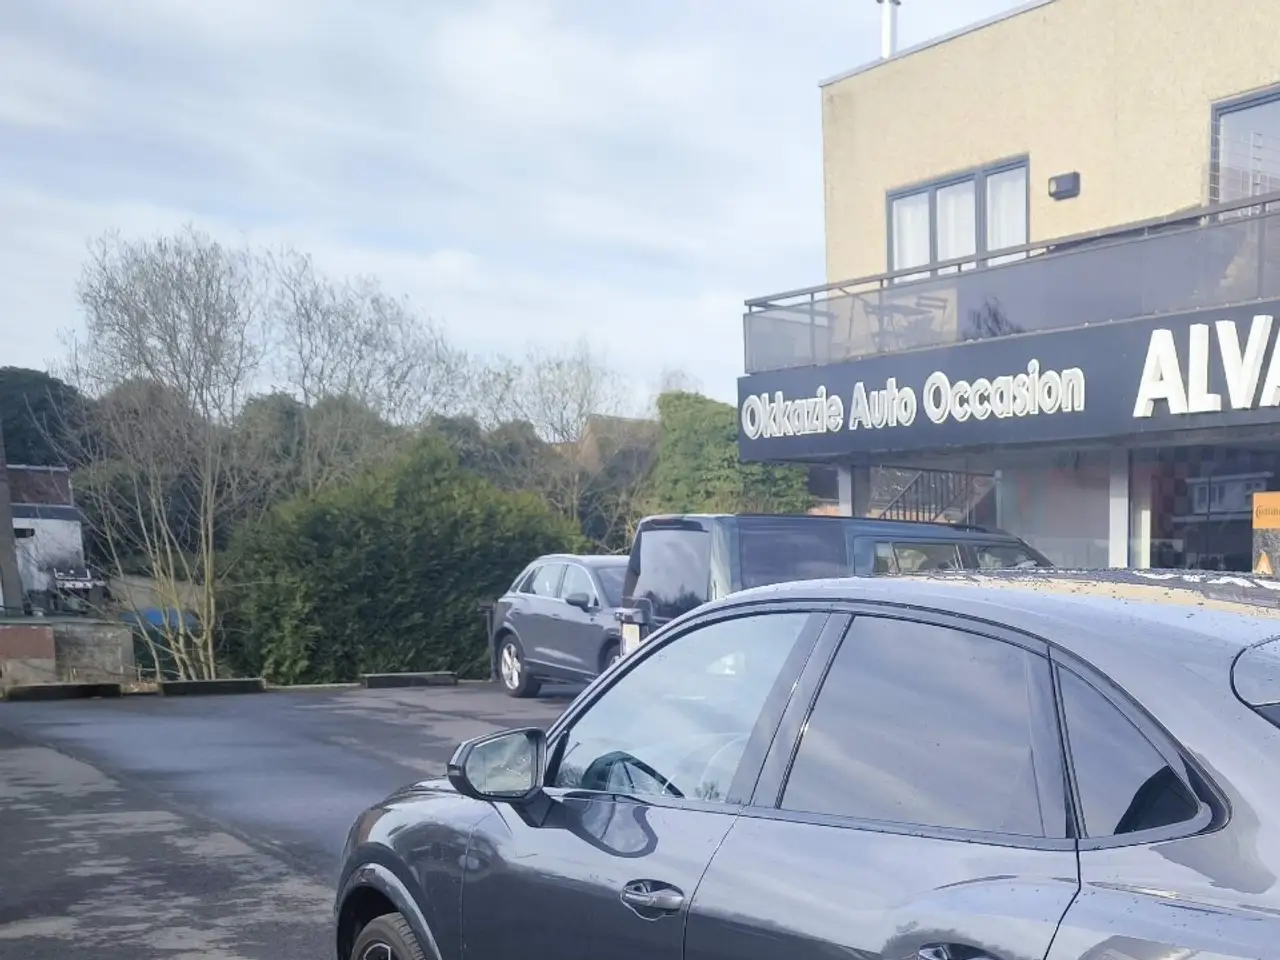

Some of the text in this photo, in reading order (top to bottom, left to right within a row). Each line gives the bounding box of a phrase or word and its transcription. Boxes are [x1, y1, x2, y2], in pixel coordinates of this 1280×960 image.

[741, 359, 1085, 440] Okkazie Auto Occasion
